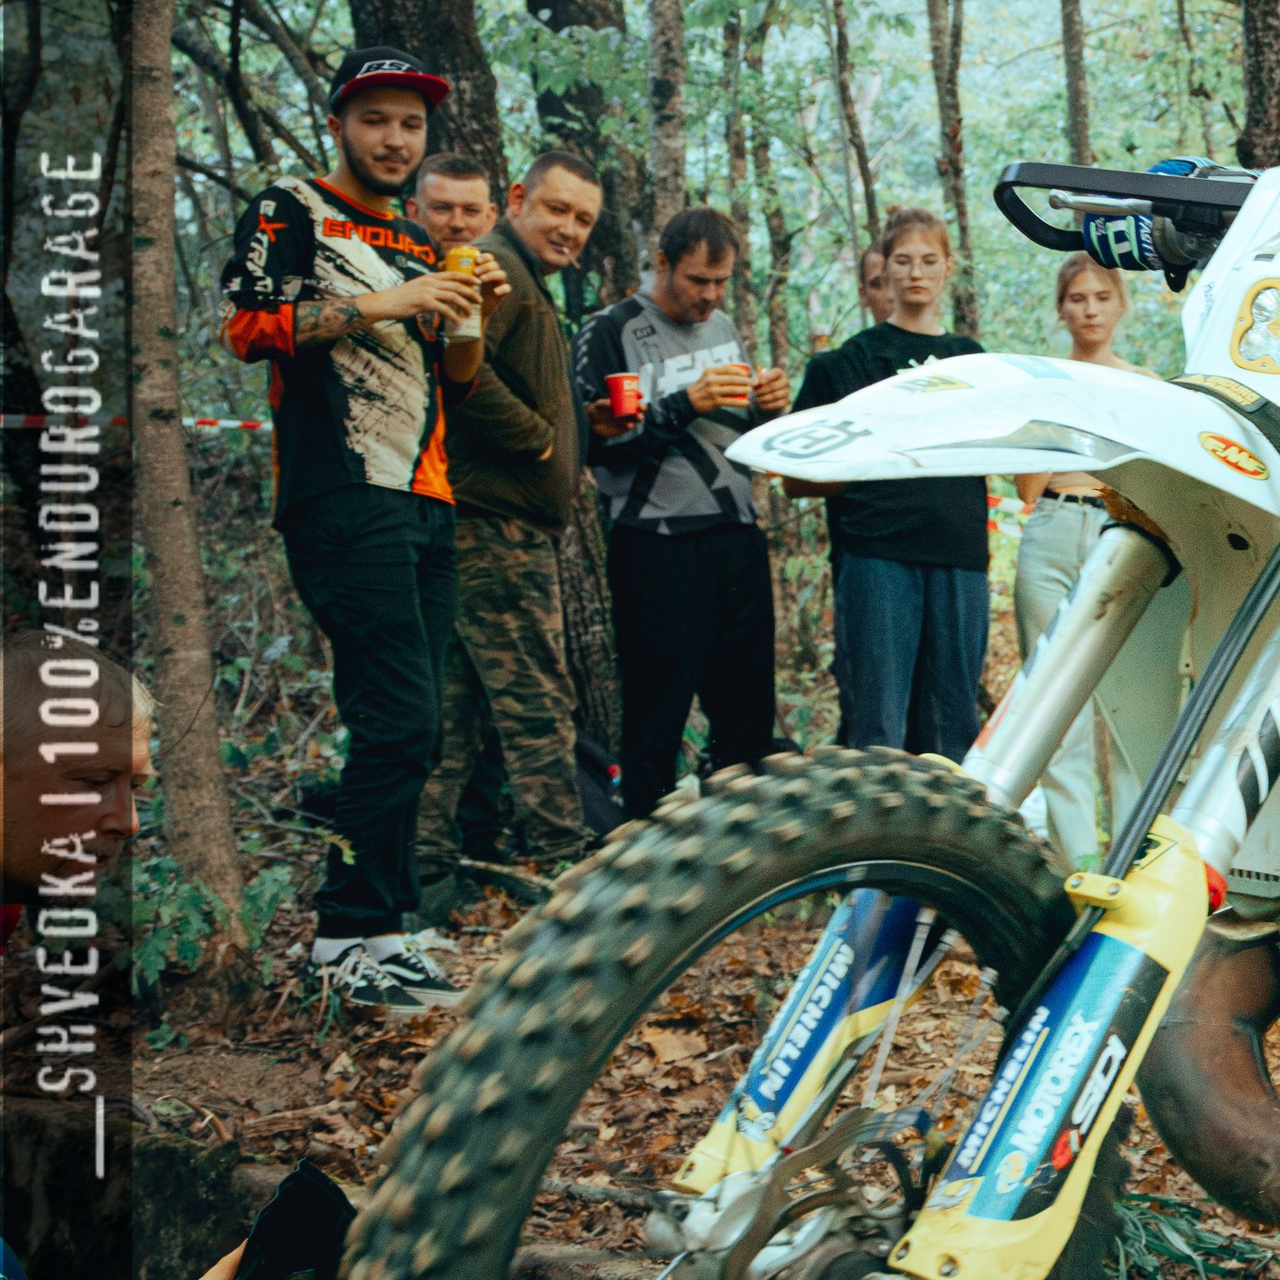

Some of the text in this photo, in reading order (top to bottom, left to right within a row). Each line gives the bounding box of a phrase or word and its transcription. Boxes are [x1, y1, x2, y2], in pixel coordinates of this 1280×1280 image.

[322, 217, 437, 266] ENDURO
[1202, 437, 1267, 475] FMF
[758, 943, 855, 1101] MICHELIN
[956, 1005, 1051, 1169] MICHELIN
[1009, 1010, 1104, 1155] MOTOREX
